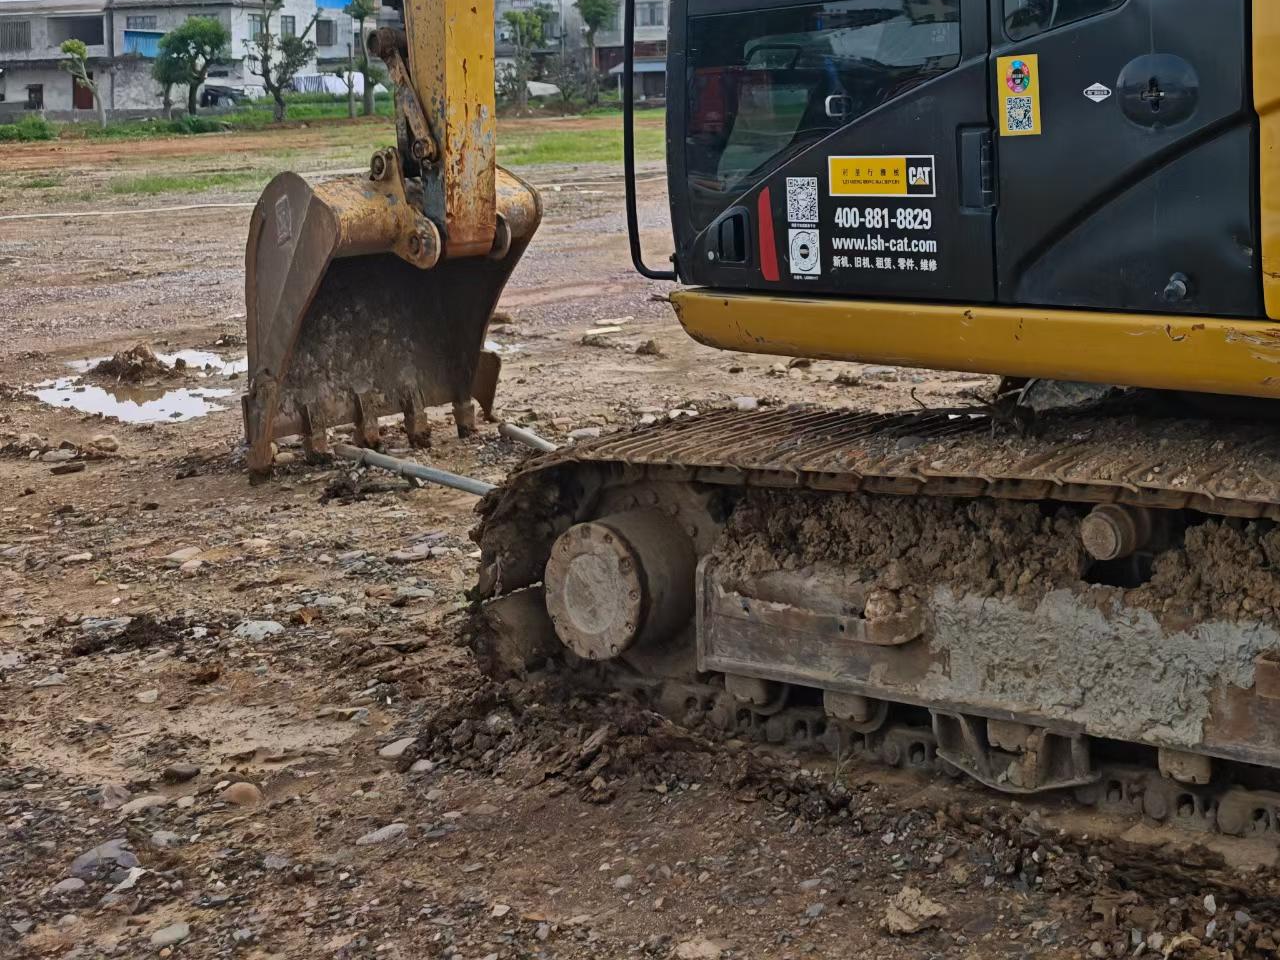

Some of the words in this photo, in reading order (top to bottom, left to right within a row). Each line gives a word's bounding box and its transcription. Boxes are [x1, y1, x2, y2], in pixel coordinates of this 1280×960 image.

[908, 166, 931, 185] CAT
[834, 207, 932, 230] 400-881-8829
[831, 233, 937, 253] www.lsh-cat.com
